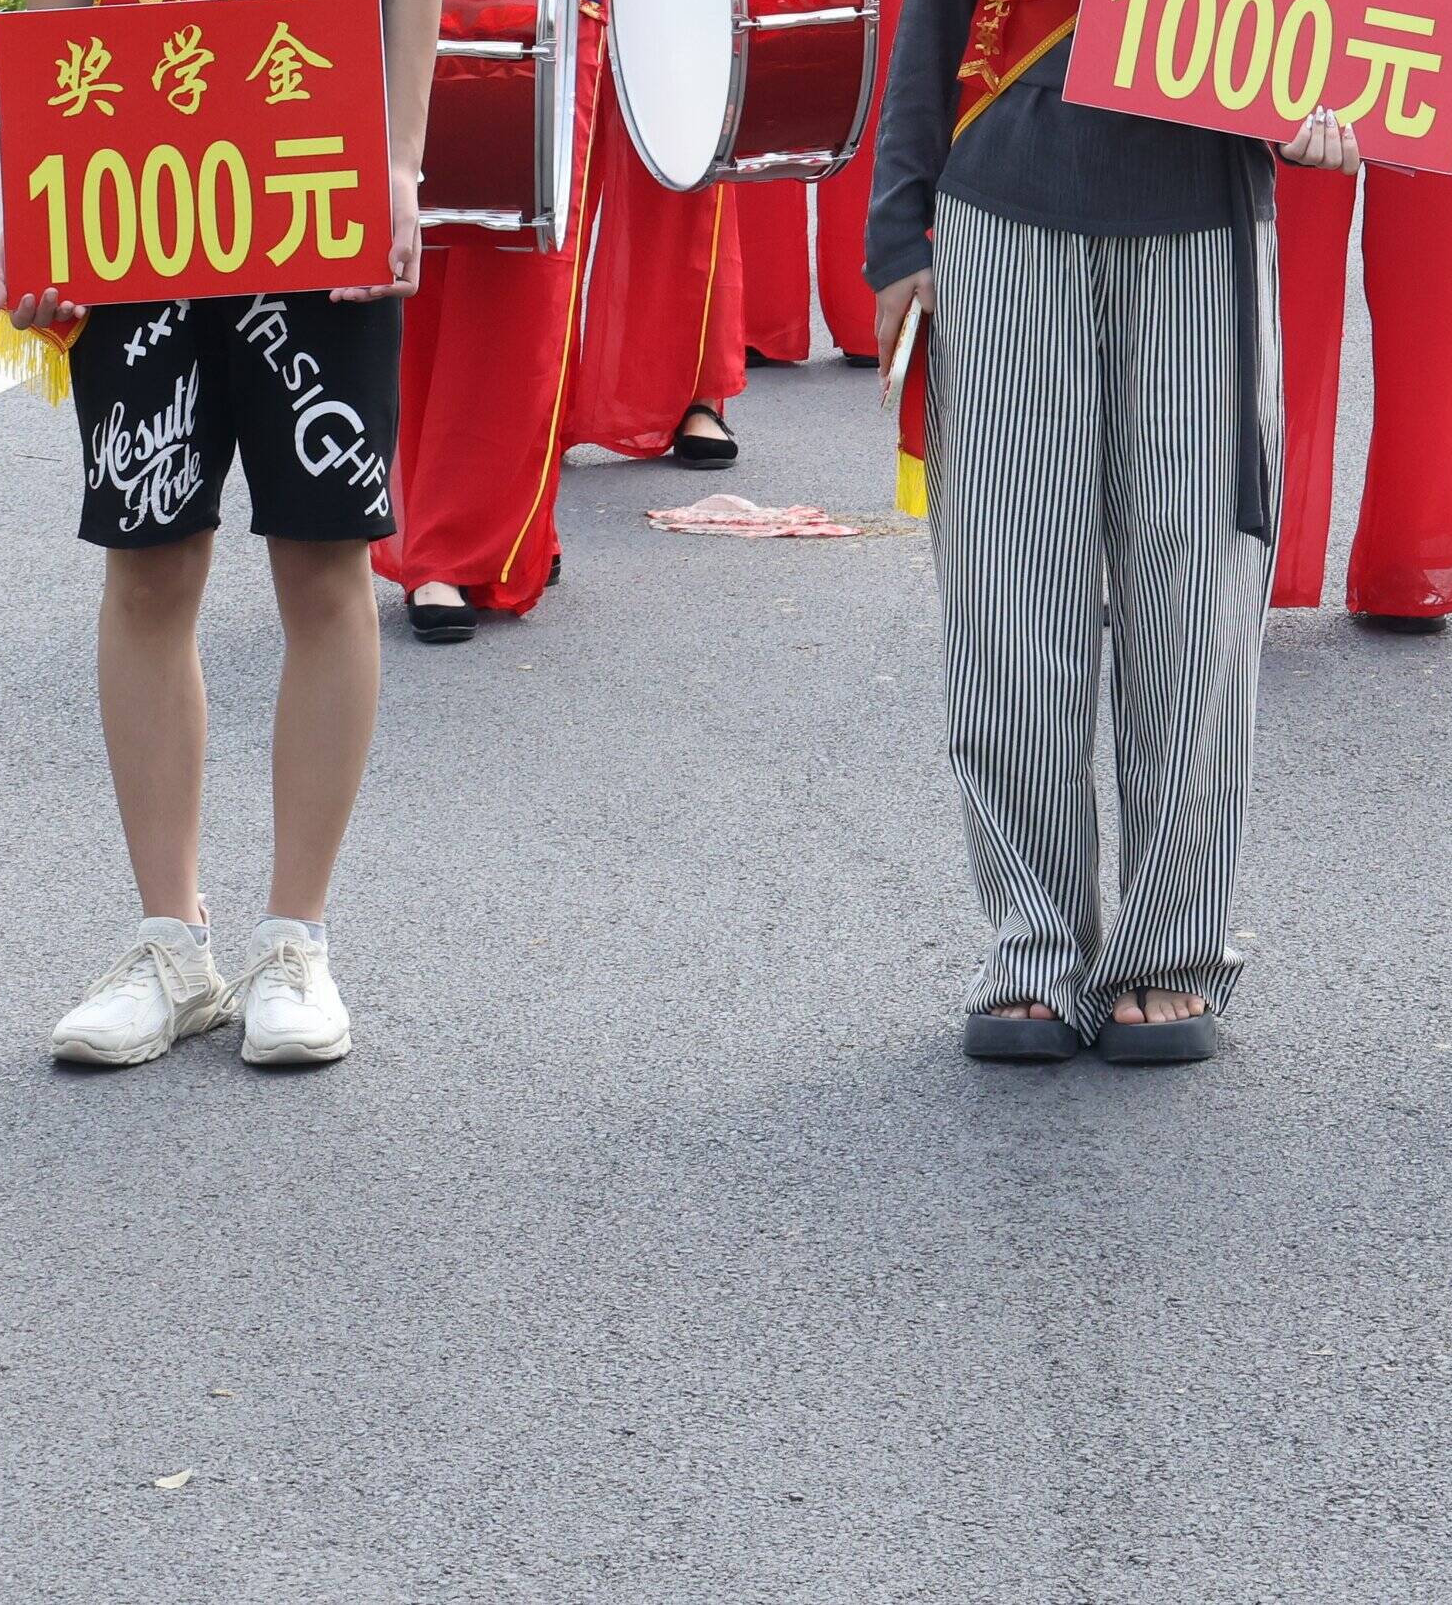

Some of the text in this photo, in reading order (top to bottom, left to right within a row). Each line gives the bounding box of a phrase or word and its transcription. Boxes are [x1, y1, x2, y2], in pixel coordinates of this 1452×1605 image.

[47, 22, 333, 117] 奖学金
[28, 135, 364, 285] 1000元
